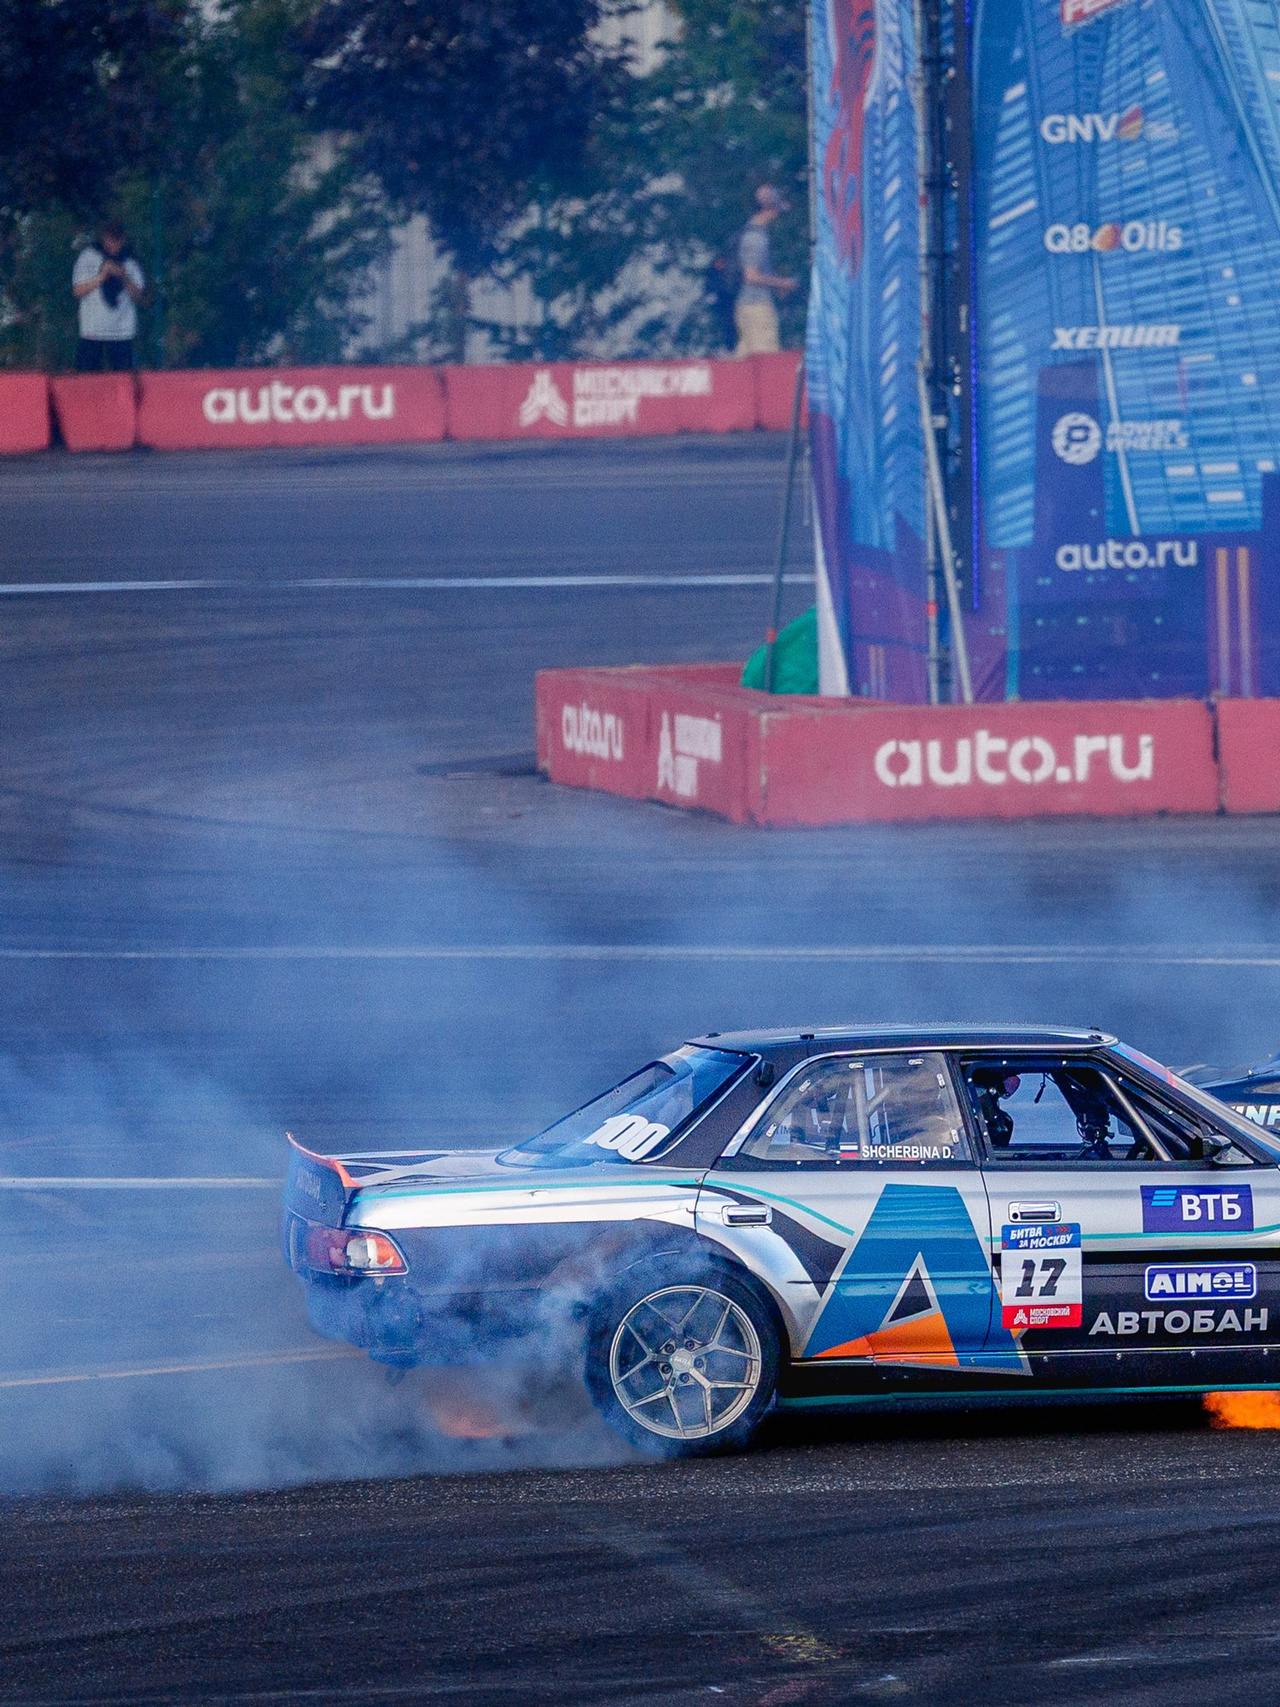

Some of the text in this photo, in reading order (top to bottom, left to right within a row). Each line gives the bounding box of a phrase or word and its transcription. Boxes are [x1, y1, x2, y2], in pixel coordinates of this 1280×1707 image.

[1040, 113, 1120, 143] GNV
[1043, 220, 1183, 253] Q8 Oils
[202, 380, 396, 425] auto.ru
[1055, 538, 1198, 572] auto.ru
[874, 729, 1154, 787] auto.ru
[582, 1113, 670, 1161] 100
[862, 1145, 954, 1159] SHCHERBINA D.
[1181, 1193, 1242, 1221] ВТБ
[1010, 1226, 1042, 1240] БИТВА
[1019, 1233, 1073, 1249] ЗА МОСКВУ
[1015, 1258, 1067, 1297] 17
[1088, 1308, 1269, 1336] АВТОБАН
